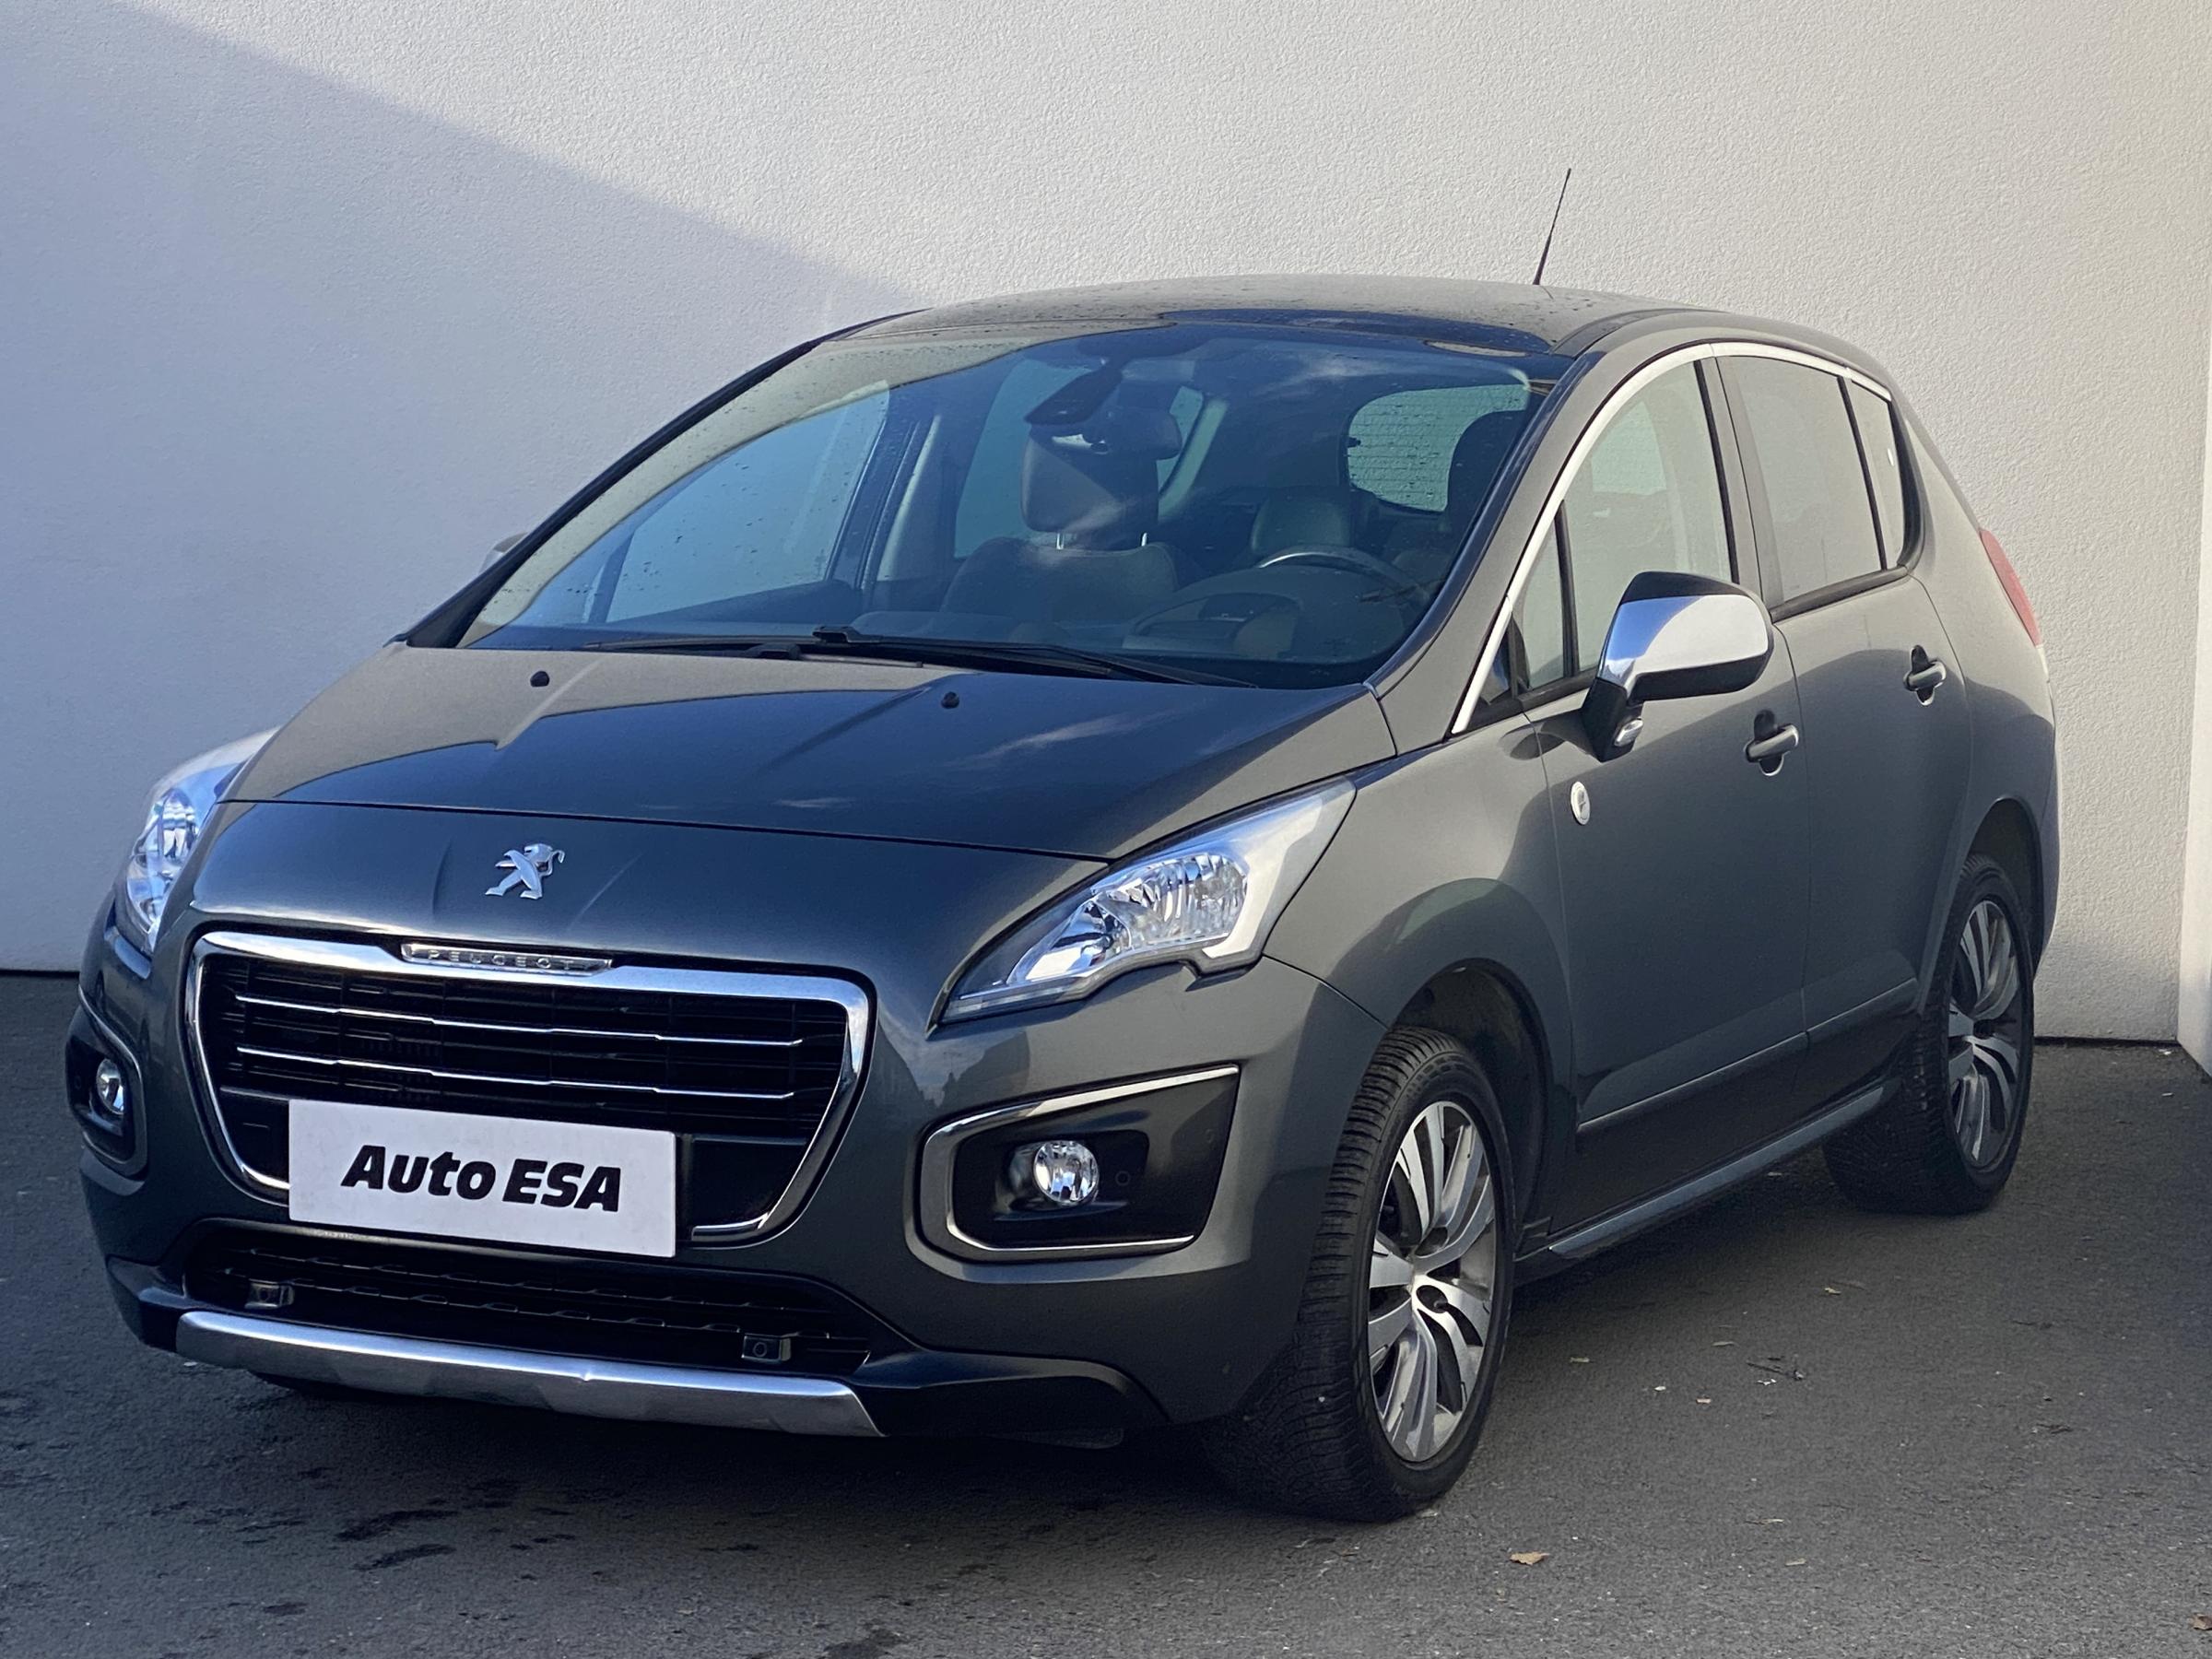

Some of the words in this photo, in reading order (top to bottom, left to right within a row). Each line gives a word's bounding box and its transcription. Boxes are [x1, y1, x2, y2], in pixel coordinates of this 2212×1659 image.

[427, 948, 575, 971] PEUGEOT
[340, 1144, 497, 1200] Auto
[501, 1158, 621, 1212] ESA
